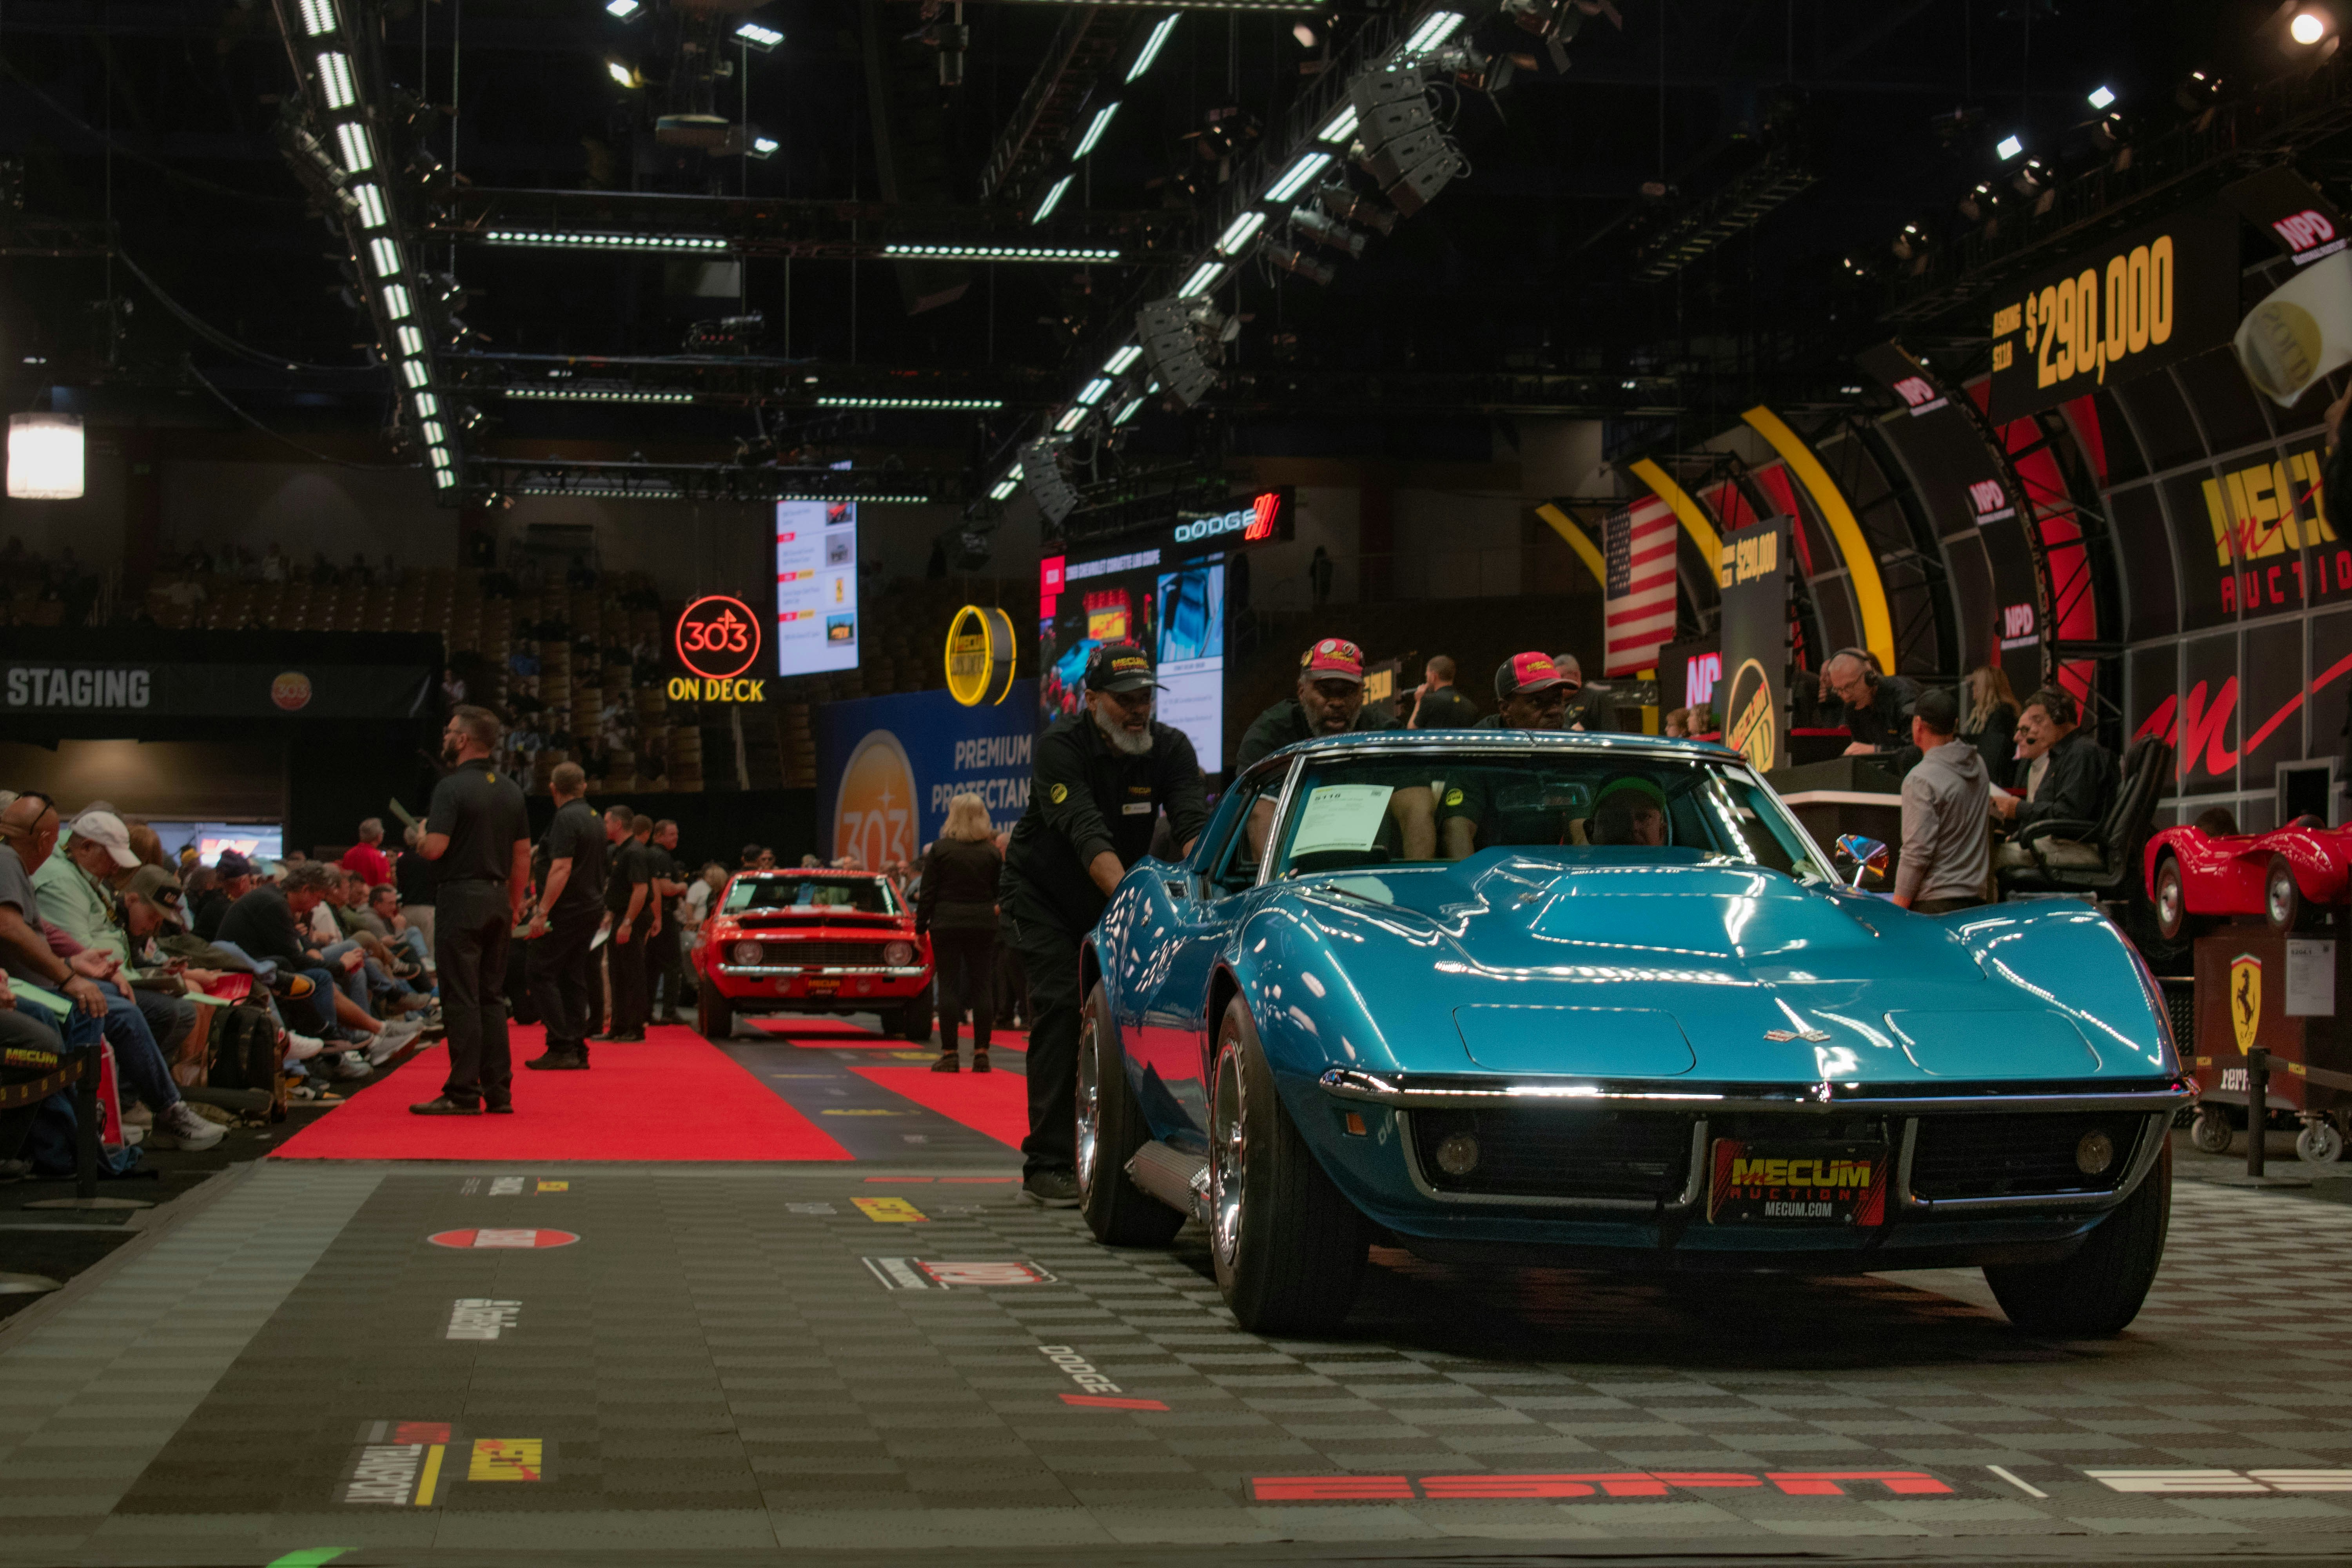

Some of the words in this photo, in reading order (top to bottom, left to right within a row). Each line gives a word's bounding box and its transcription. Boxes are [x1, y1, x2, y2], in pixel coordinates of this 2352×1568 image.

[2272, 209, 2334, 252] NPD
[2025, 234, 2174, 390] $290,000
[1969, 479, 2005, 514] NPD
[2201, 450, 2337, 567] MECU
[1174, 508, 1257, 543] DODGE
[1737, 530, 1777, 585] $290,000
[684, 622, 748, 652] 303
[2004, 603, 2034, 639] NPD
[7, 668, 151, 708] STAGING
[276, 683, 311, 699] 303
[668, 677, 699, 701] ON
[704, 678, 765, 702] DECK
[1686, 651, 1722, 710] NP
[954, 733, 1032, 771] PREMIUM
[931, 777, 1031, 813] PRECTAN
[843, 808, 909, 871] 303
[5, 1047, 58, 1064] MECUM
[1732, 1158, 1871, 1187] MECUM
[1730, 1187, 1869, 1200] AUCTIONS
[1764, 1201, 1832, 1218] MECUM.COM
[1038, 1345, 1122, 1394] DODGE
[344, 1443, 424, 1505] TRANSPORT
[1252, 1470, 1956, 1501] ESPN
